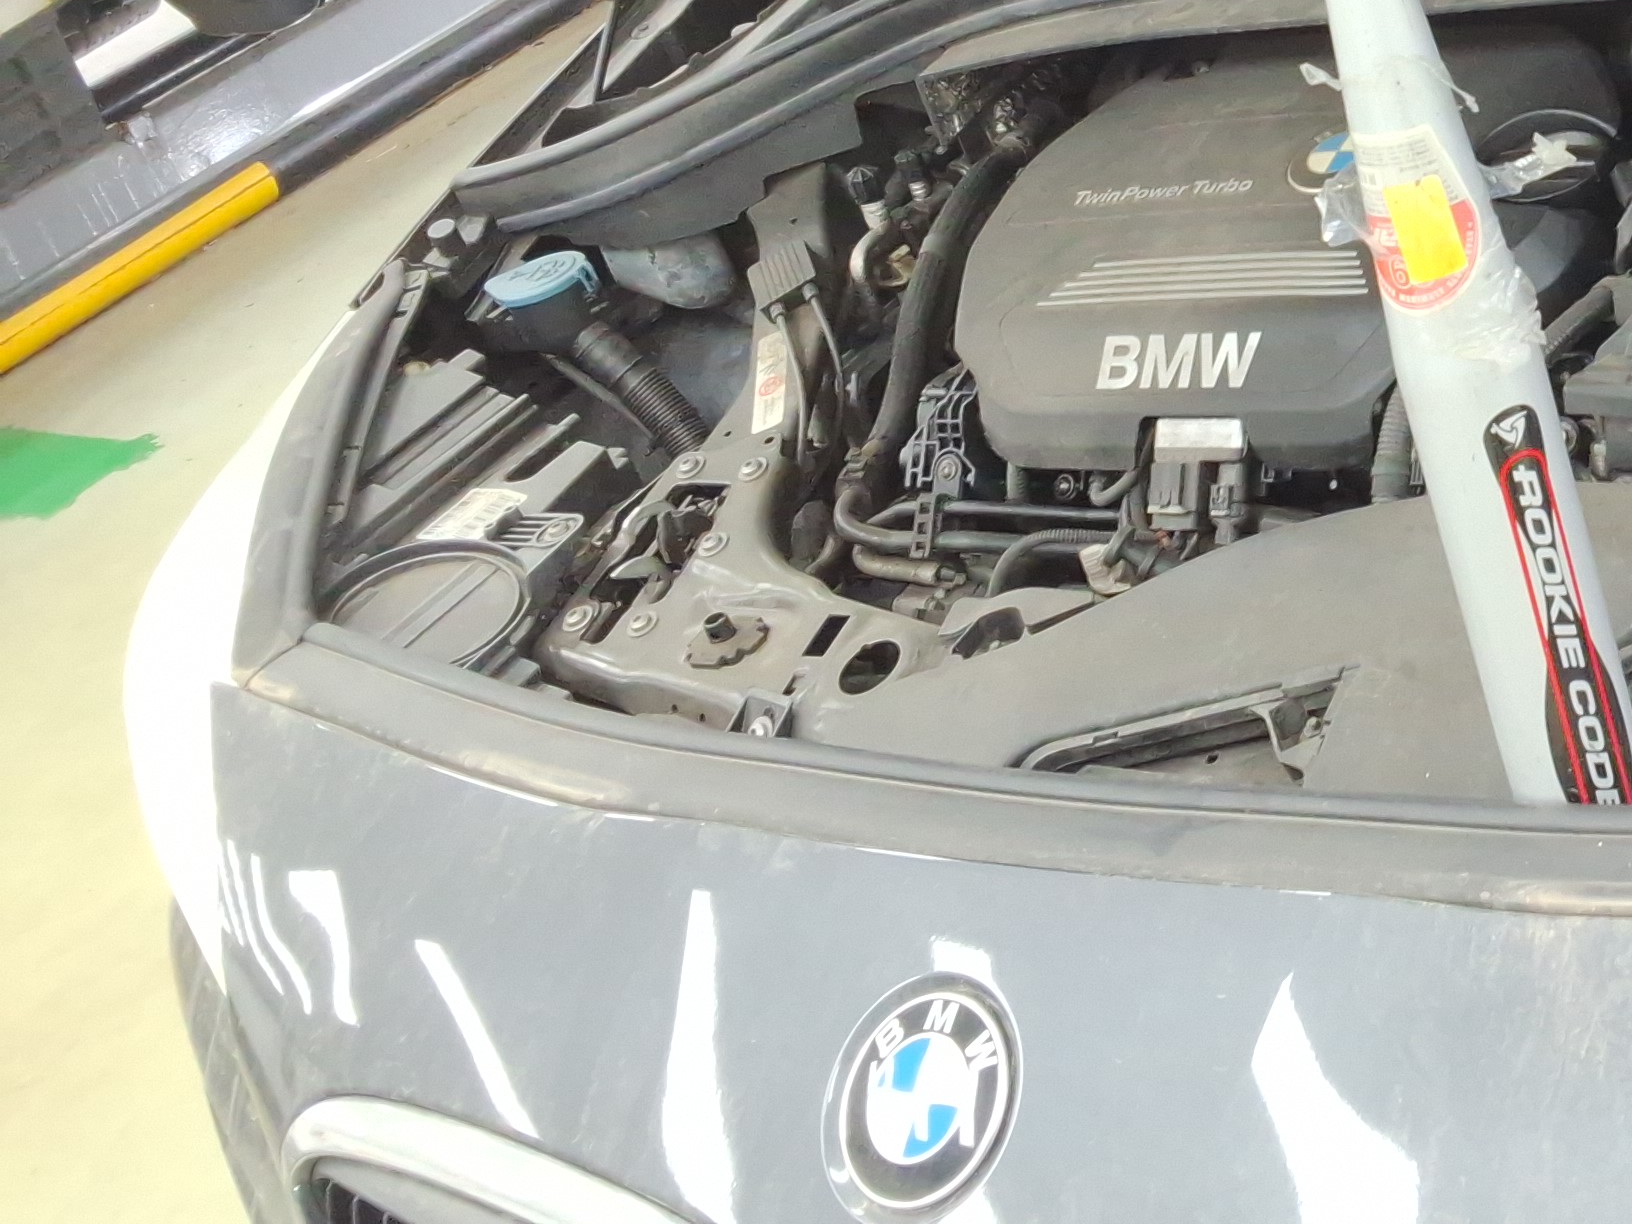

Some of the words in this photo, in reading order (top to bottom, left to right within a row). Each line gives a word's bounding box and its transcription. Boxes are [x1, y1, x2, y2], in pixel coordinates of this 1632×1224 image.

[1192, 177, 1254, 195] Turbo
[1095, 331, 1263, 390] BMW
[1512, 464, 1586, 669] ROOKIE
[874, 999, 999, 1073] BMW
